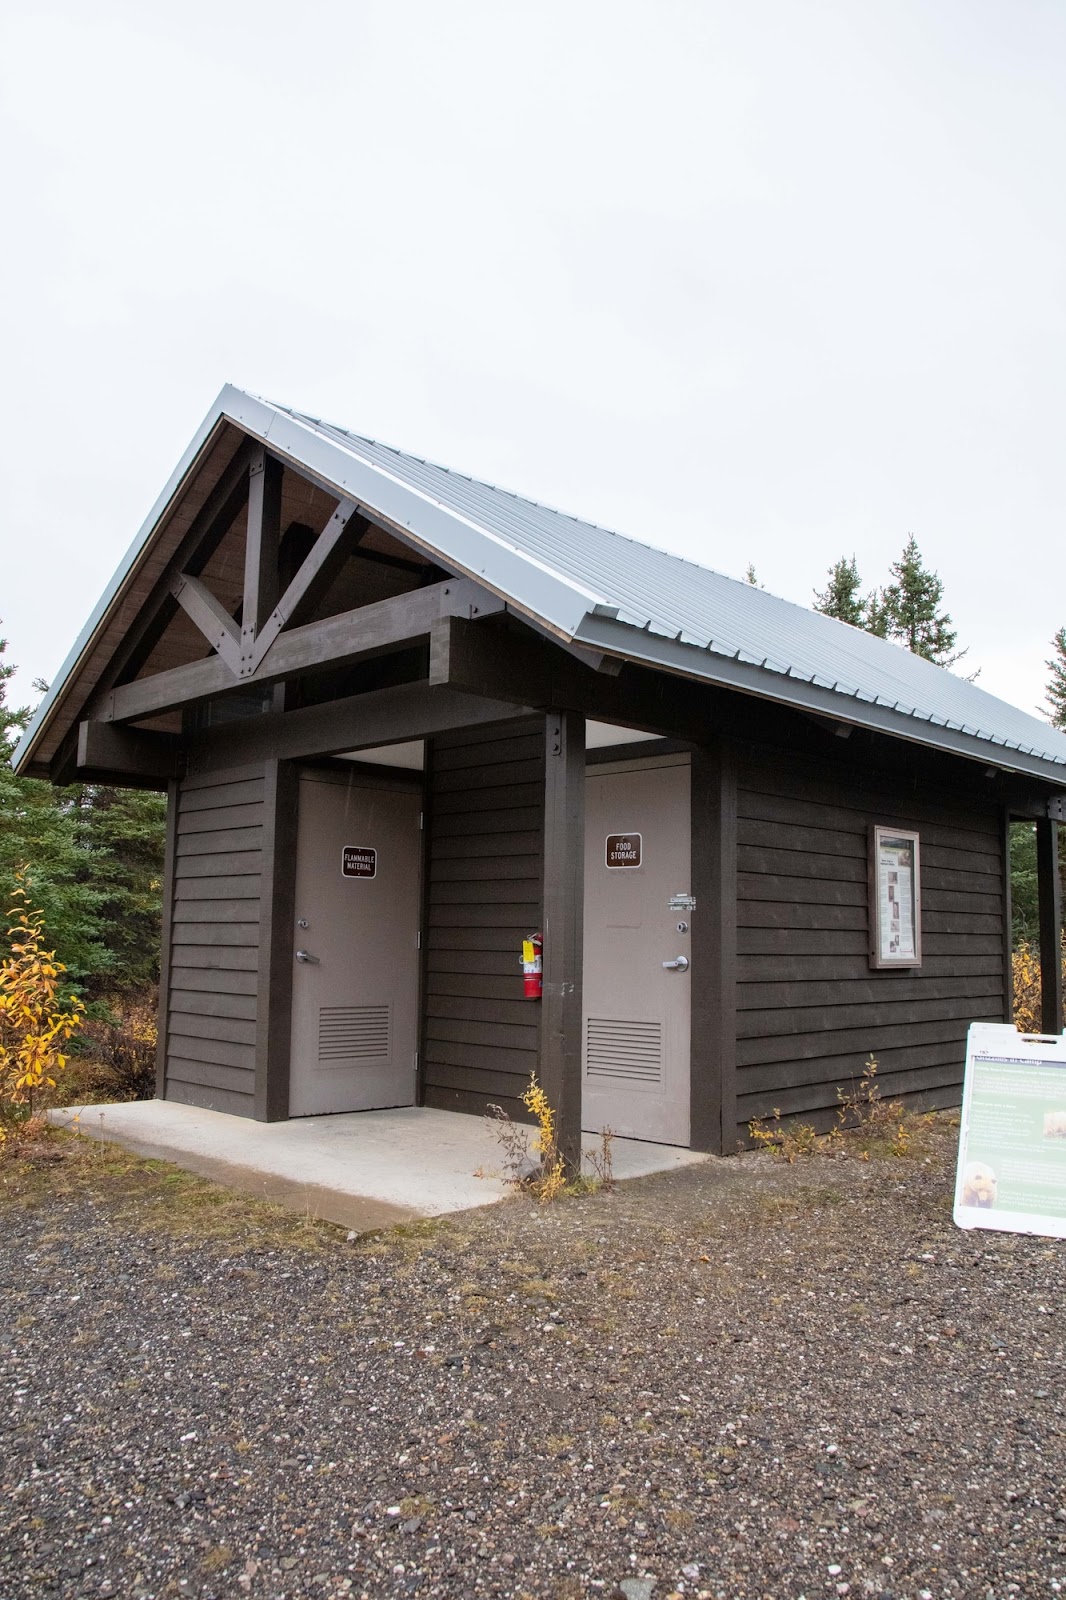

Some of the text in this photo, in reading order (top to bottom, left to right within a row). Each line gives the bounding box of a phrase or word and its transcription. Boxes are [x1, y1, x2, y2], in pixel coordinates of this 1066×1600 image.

[345, 854, 374, 863] FLAMMABLE
[611, 851, 636, 860] STORAGE
[347, 862, 371, 871] MATERIAL
